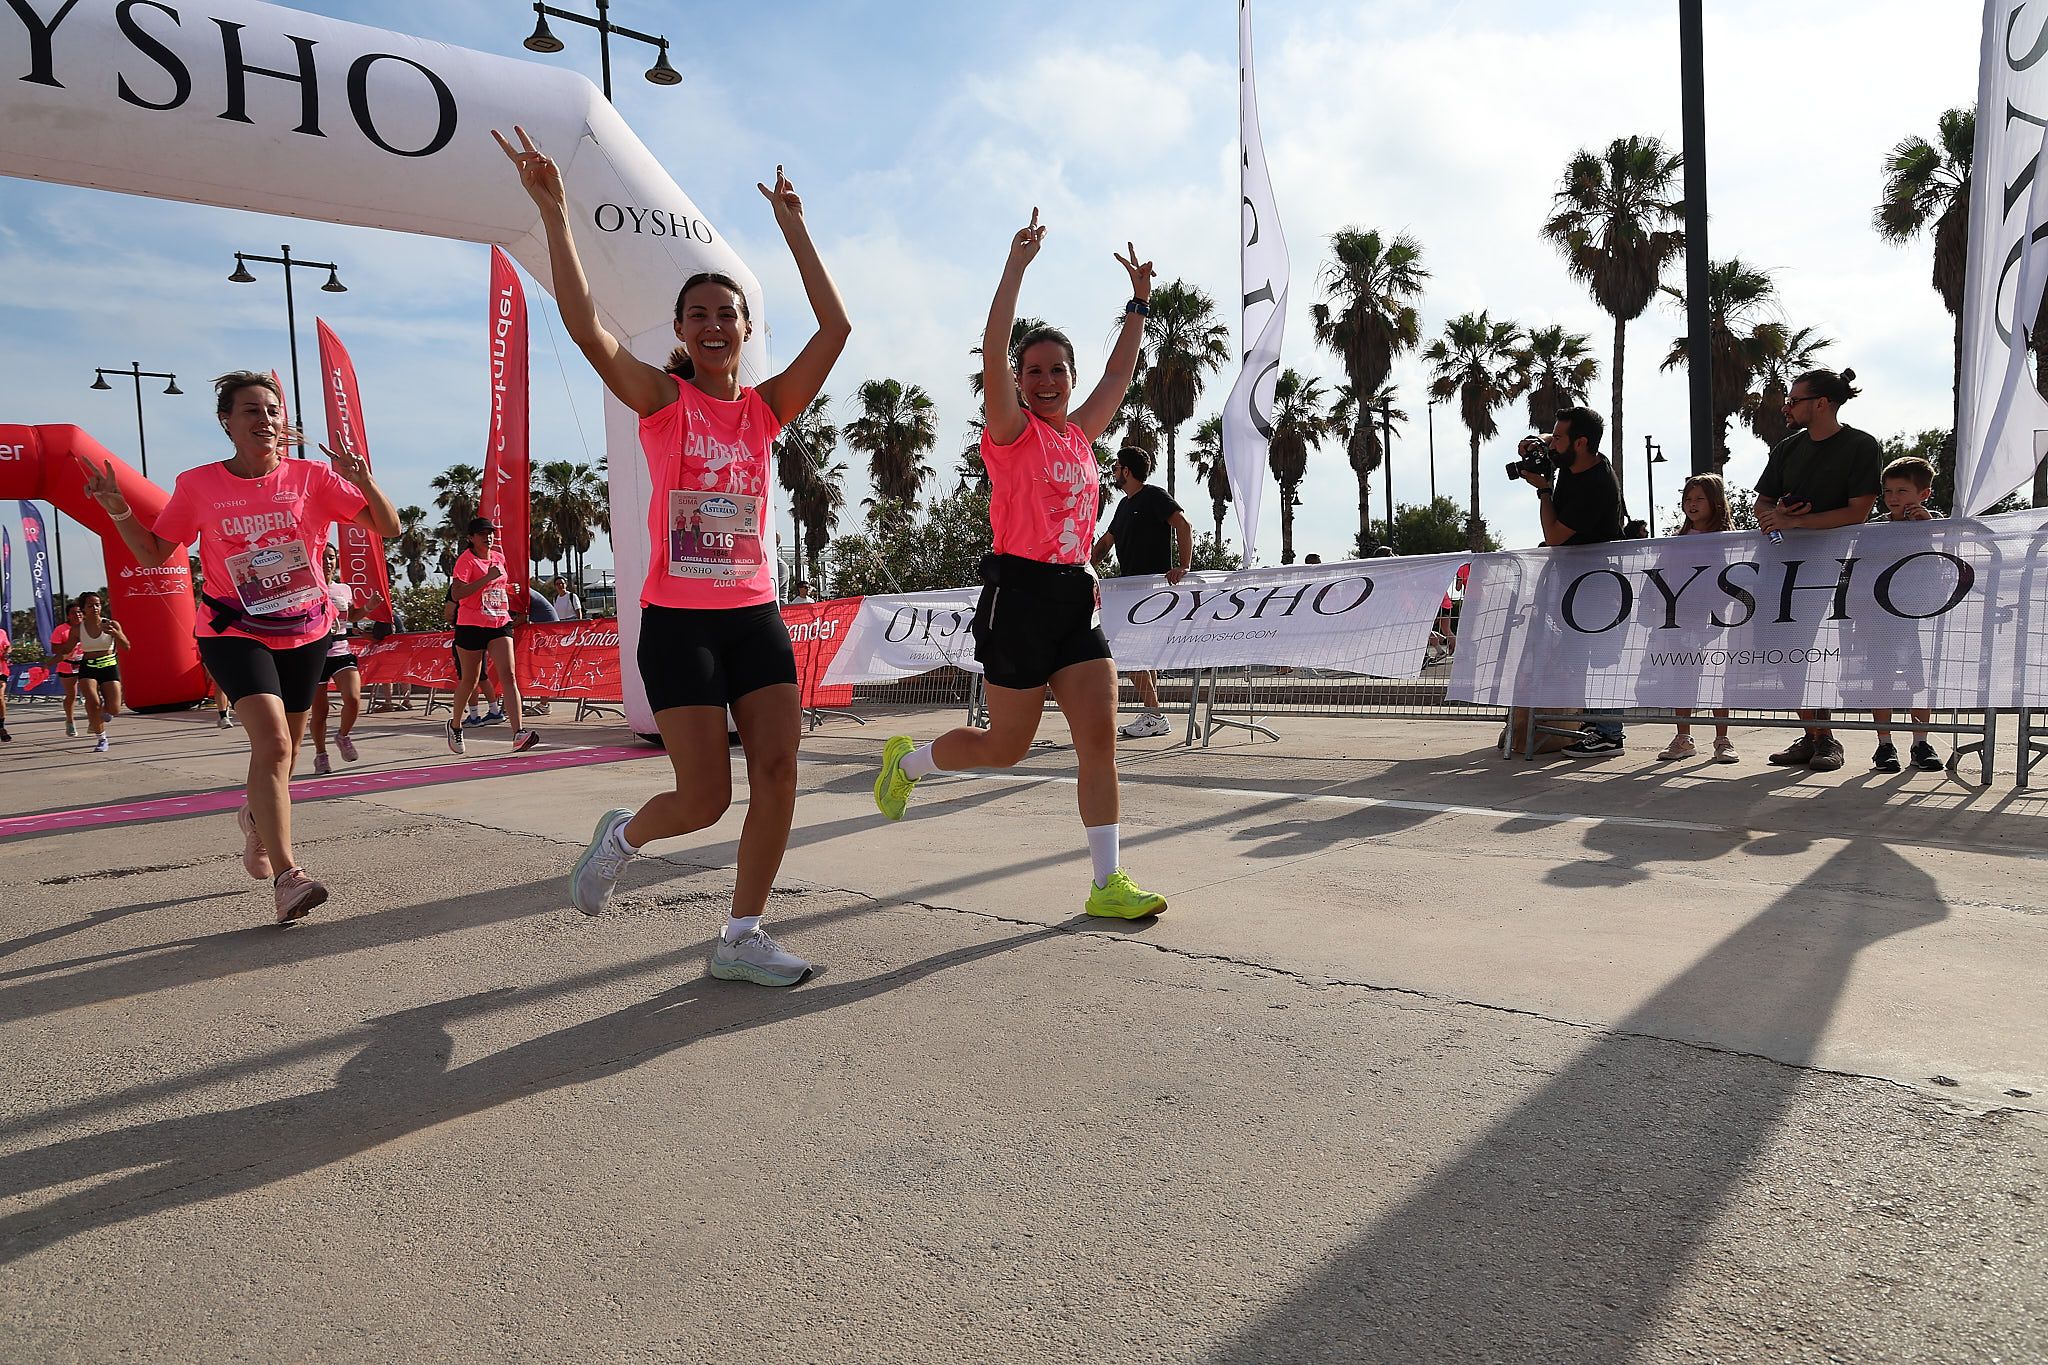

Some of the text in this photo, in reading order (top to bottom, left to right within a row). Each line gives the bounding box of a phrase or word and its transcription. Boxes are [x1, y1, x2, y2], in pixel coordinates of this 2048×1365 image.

[595, 204, 712, 244] OYSHO
[0, 445, 24, 461] er
[213, 499, 247, 510] OYSHO
[702, 532, 735, 548] 016
[134, 565, 188, 579] Santander
[681, 565, 712, 575] OYSHO
[262, 571, 291, 589] 016
[1127, 576, 1376, 625] OYSHO
[1561, 550, 1976, 634] OYSHO
[784, 617, 840, 641] ander
[1165, 628, 1279, 645] WWW.OYSHO.COM
[1650, 647, 1841, 667] WWW.OYSHO.COM
